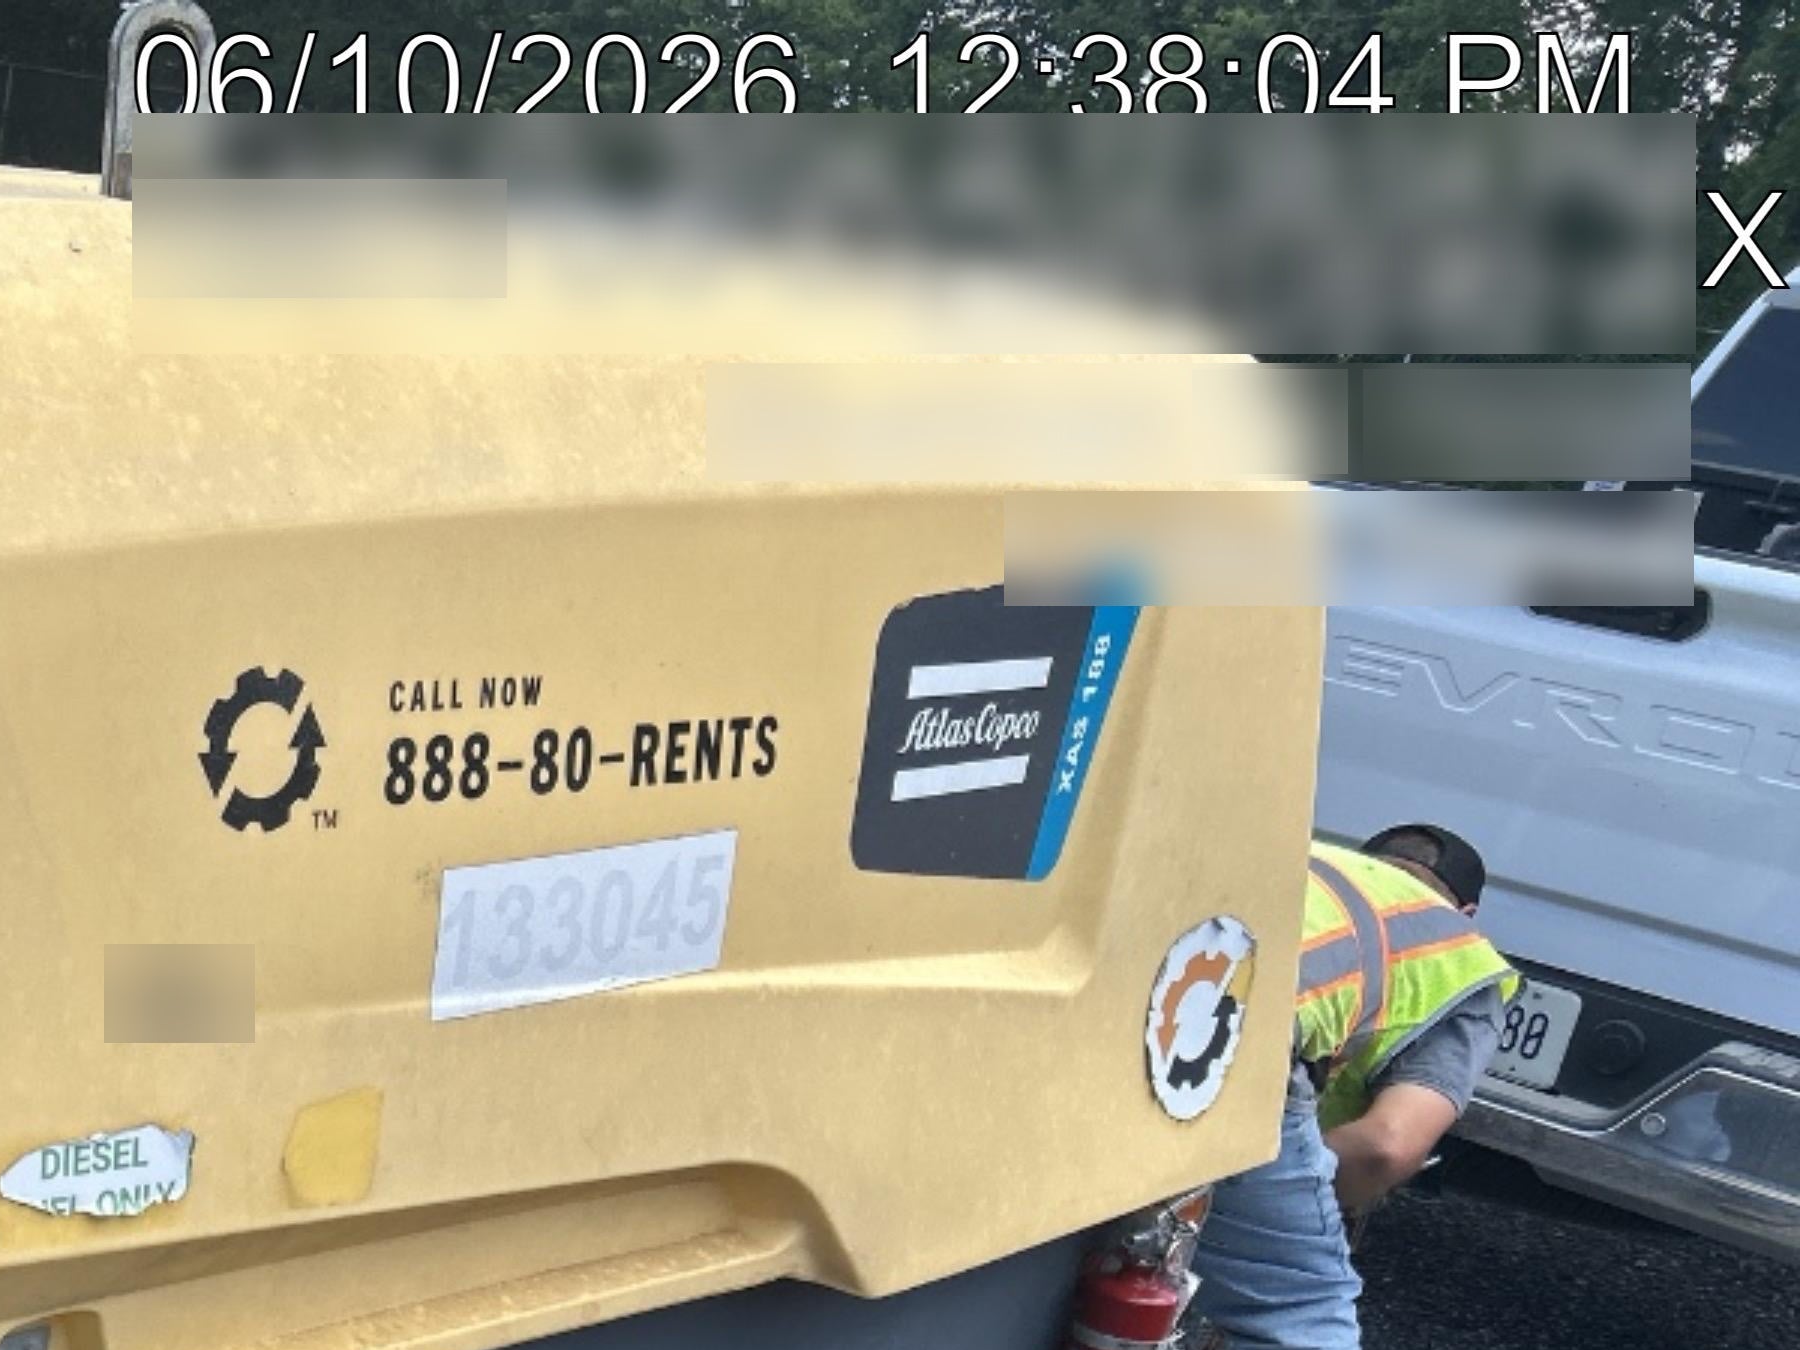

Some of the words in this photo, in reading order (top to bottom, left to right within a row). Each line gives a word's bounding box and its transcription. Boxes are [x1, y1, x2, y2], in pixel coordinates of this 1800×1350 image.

[388, 679, 464, 713] CALL
[478, 676, 544, 709] NOW
[1081, 633, 1112, 703] 188
[383, 715, 779, 806] 888-80-RENTS
[441, 853, 727, 990] 133045
[40, 1137, 149, 1180] DIESEL
